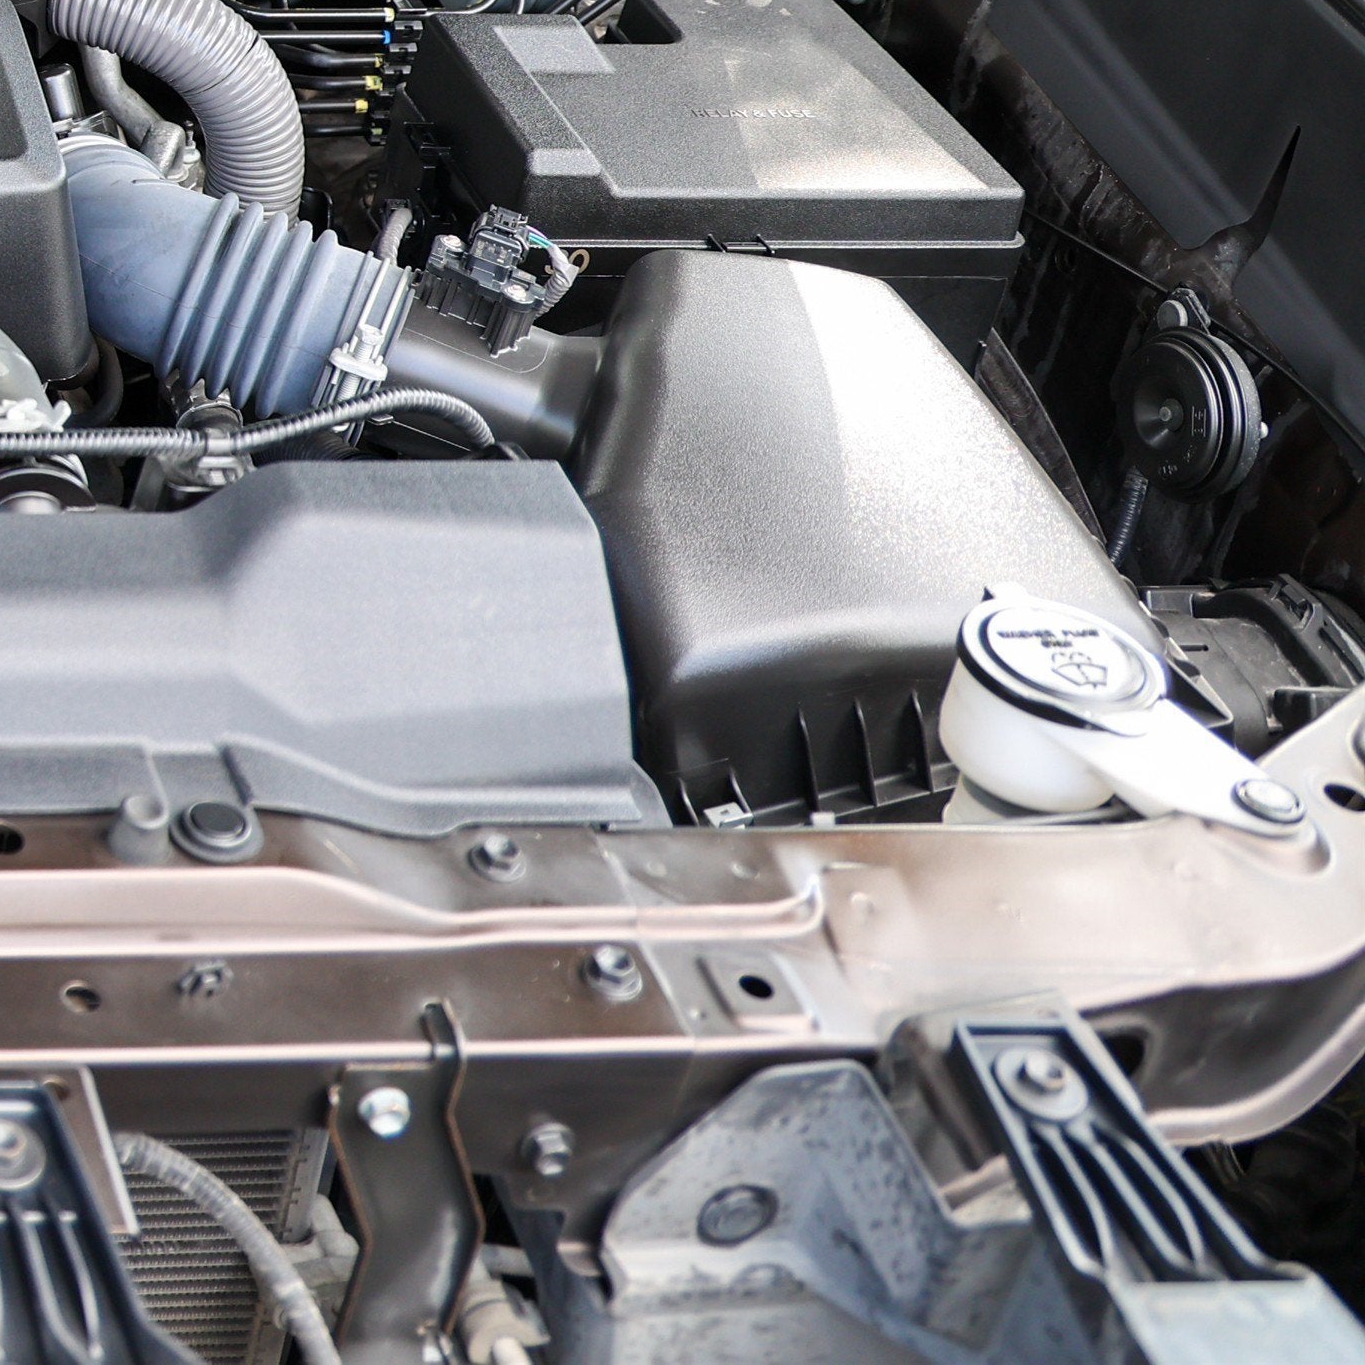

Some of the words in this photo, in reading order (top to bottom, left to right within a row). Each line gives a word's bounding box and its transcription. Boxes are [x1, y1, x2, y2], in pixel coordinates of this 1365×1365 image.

[690, 108, 749, 118] RELAY
[752, 109, 767, 118] &
[768, 109, 817, 118] FUSE
